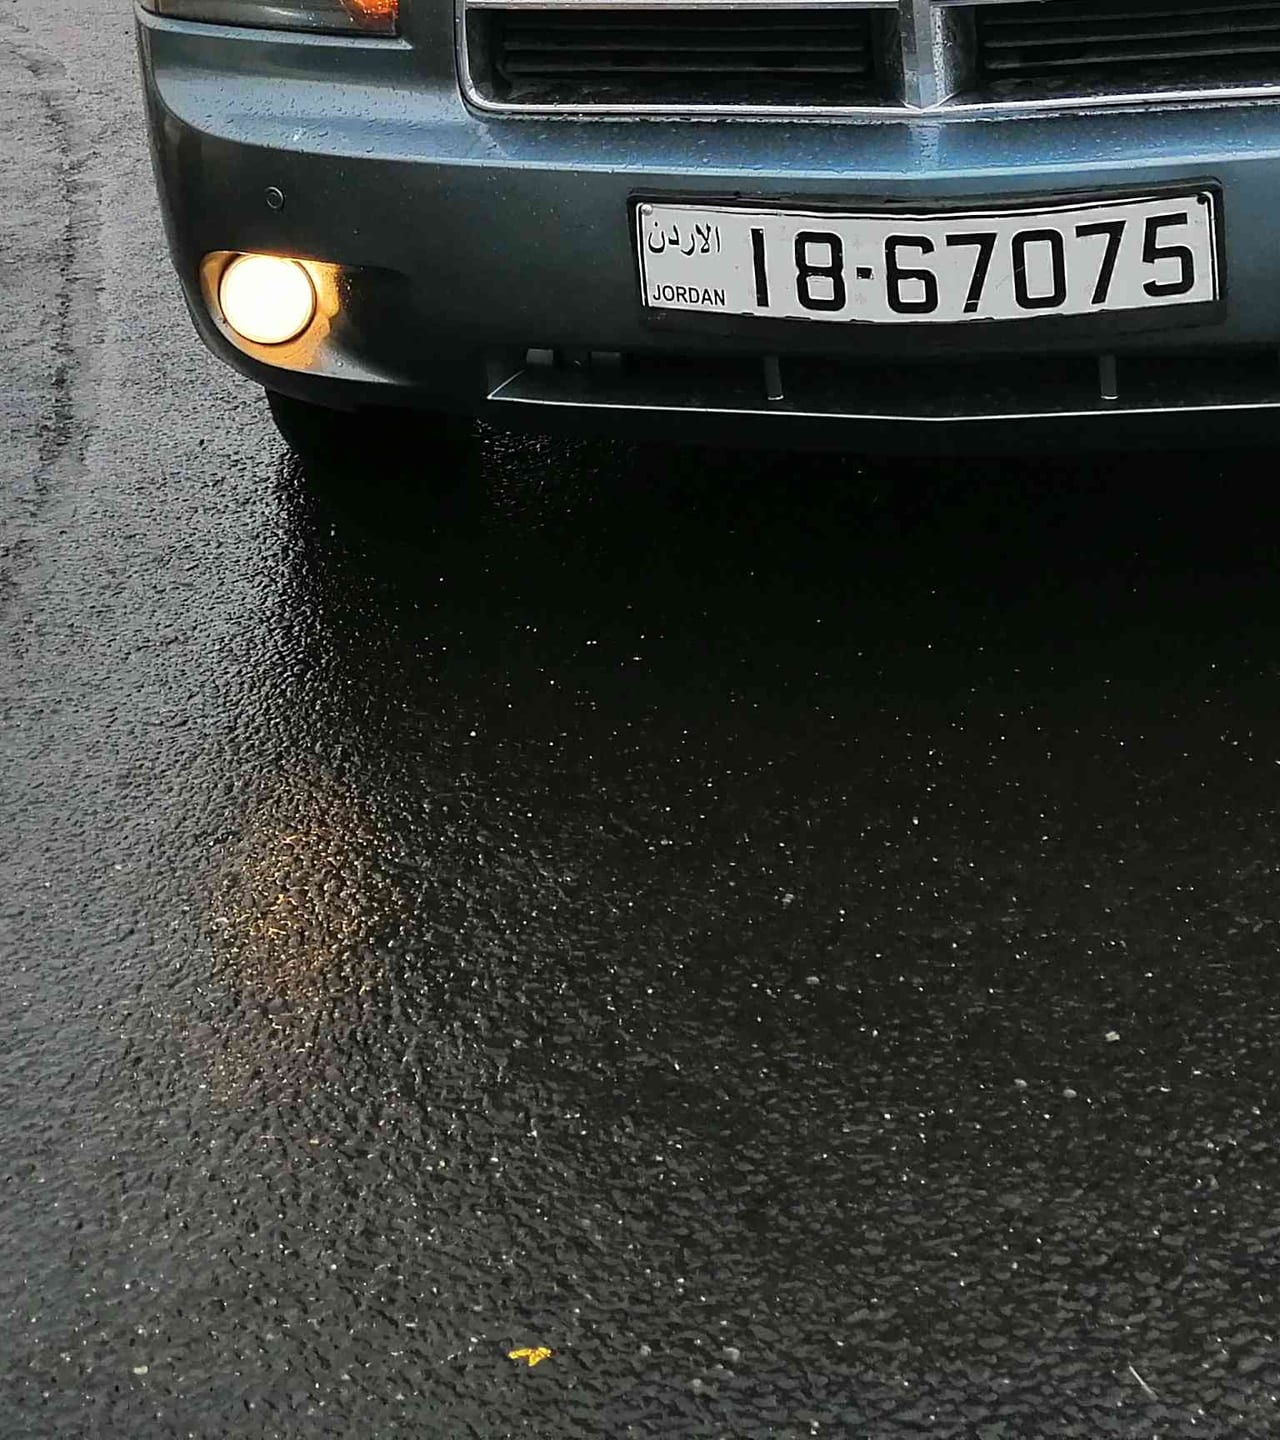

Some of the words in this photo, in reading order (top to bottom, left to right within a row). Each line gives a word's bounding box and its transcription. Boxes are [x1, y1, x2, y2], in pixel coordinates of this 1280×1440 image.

[648, 221, 721, 256] الاردن
[750, 212, 1195, 315] 18-67075
[652, 284, 725, 306] JORDAN
